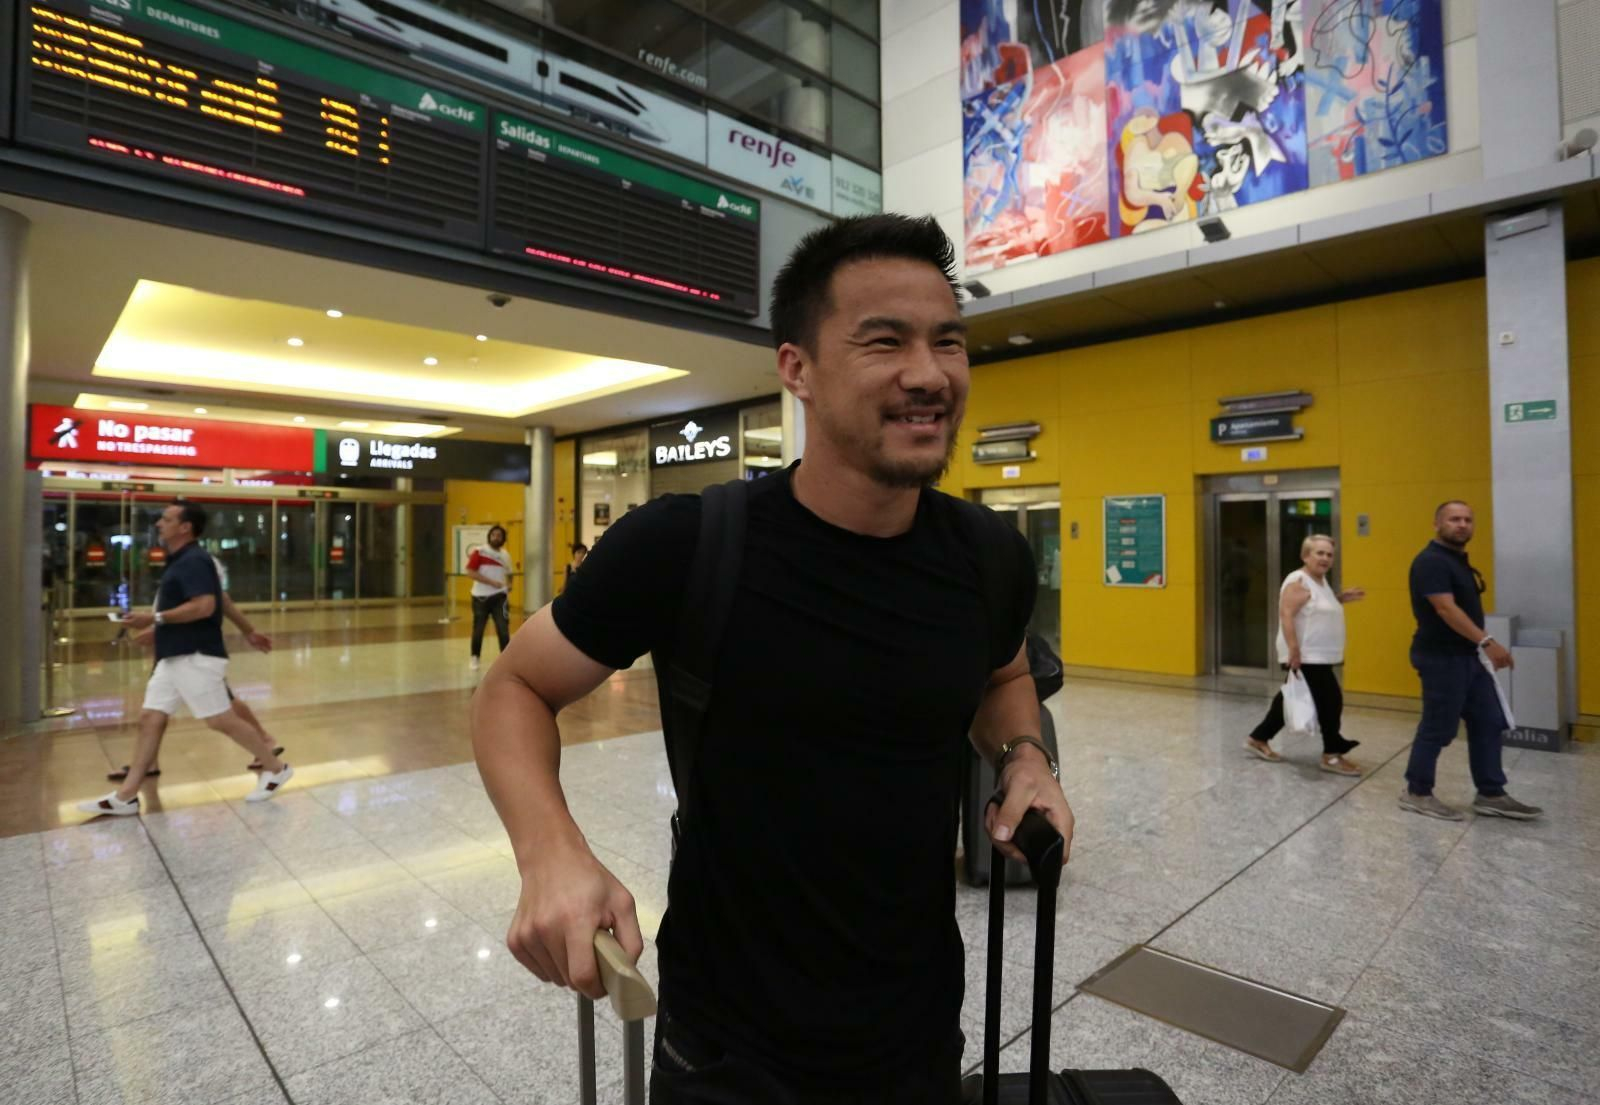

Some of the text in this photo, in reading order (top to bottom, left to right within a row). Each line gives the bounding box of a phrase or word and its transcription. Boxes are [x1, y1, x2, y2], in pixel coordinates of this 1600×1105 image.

[146, 6, 220, 39] DEPARTURES
[638, 48, 707, 90] renfe.com
[439, 104, 476, 122] adif
[500, 120, 551, 150] Salidas
[557, 143, 600, 165] DEPARTURES
[728, 129, 797, 169] renfe
[781, 175, 816, 200] AVE
[98, 419, 195, 443] No pasar
[96, 441, 198, 457] NO TRESPASSING
[369, 439, 437, 460] Llegadas
[656, 436, 731, 464] BAILEYS
[369, 458, 414, 470] ARRIVALS
